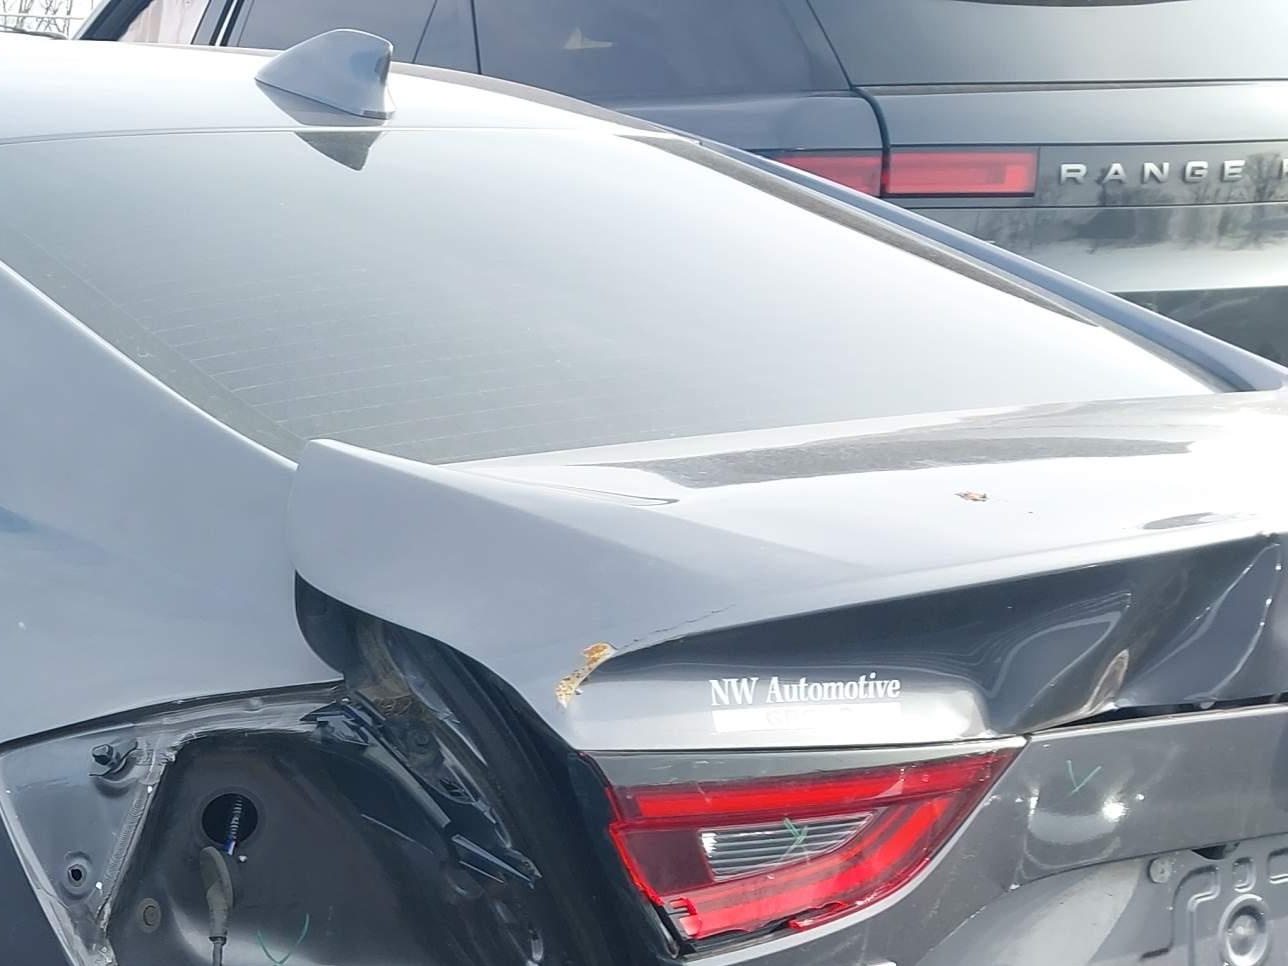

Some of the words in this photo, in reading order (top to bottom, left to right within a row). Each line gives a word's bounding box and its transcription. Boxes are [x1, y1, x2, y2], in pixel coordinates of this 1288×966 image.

[1059, 159, 1246, 185] RANGE
[709, 677, 759, 706] NW
[766, 672, 901, 703] Automotive
